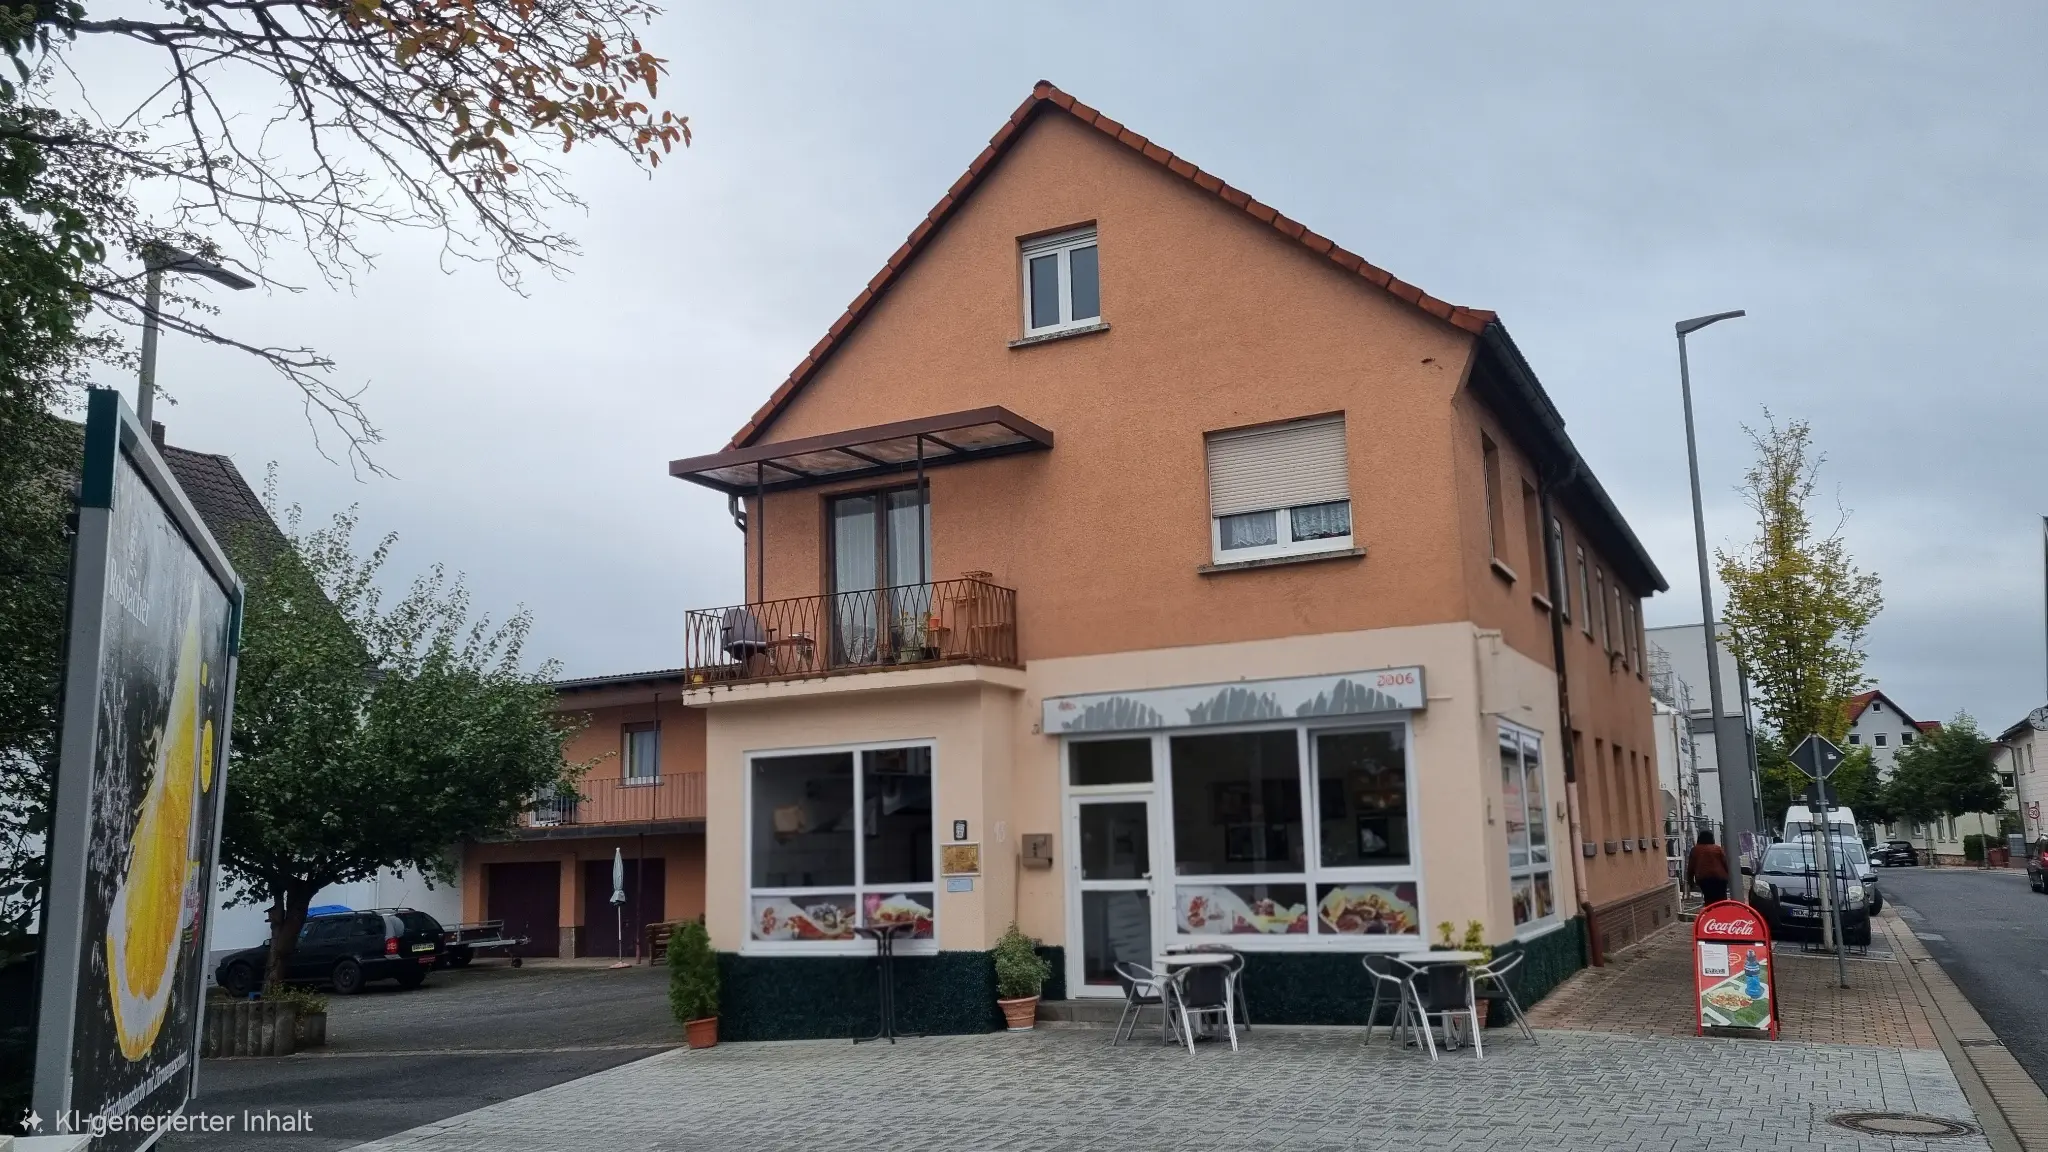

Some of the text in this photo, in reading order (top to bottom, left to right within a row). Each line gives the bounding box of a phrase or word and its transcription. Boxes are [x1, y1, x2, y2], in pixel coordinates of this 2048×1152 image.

[108, 558, 150, 627] Rosbacher
[1376, 672, 1415, 687] 2006
[1703, 918, 1756, 936] Coca-Cola
